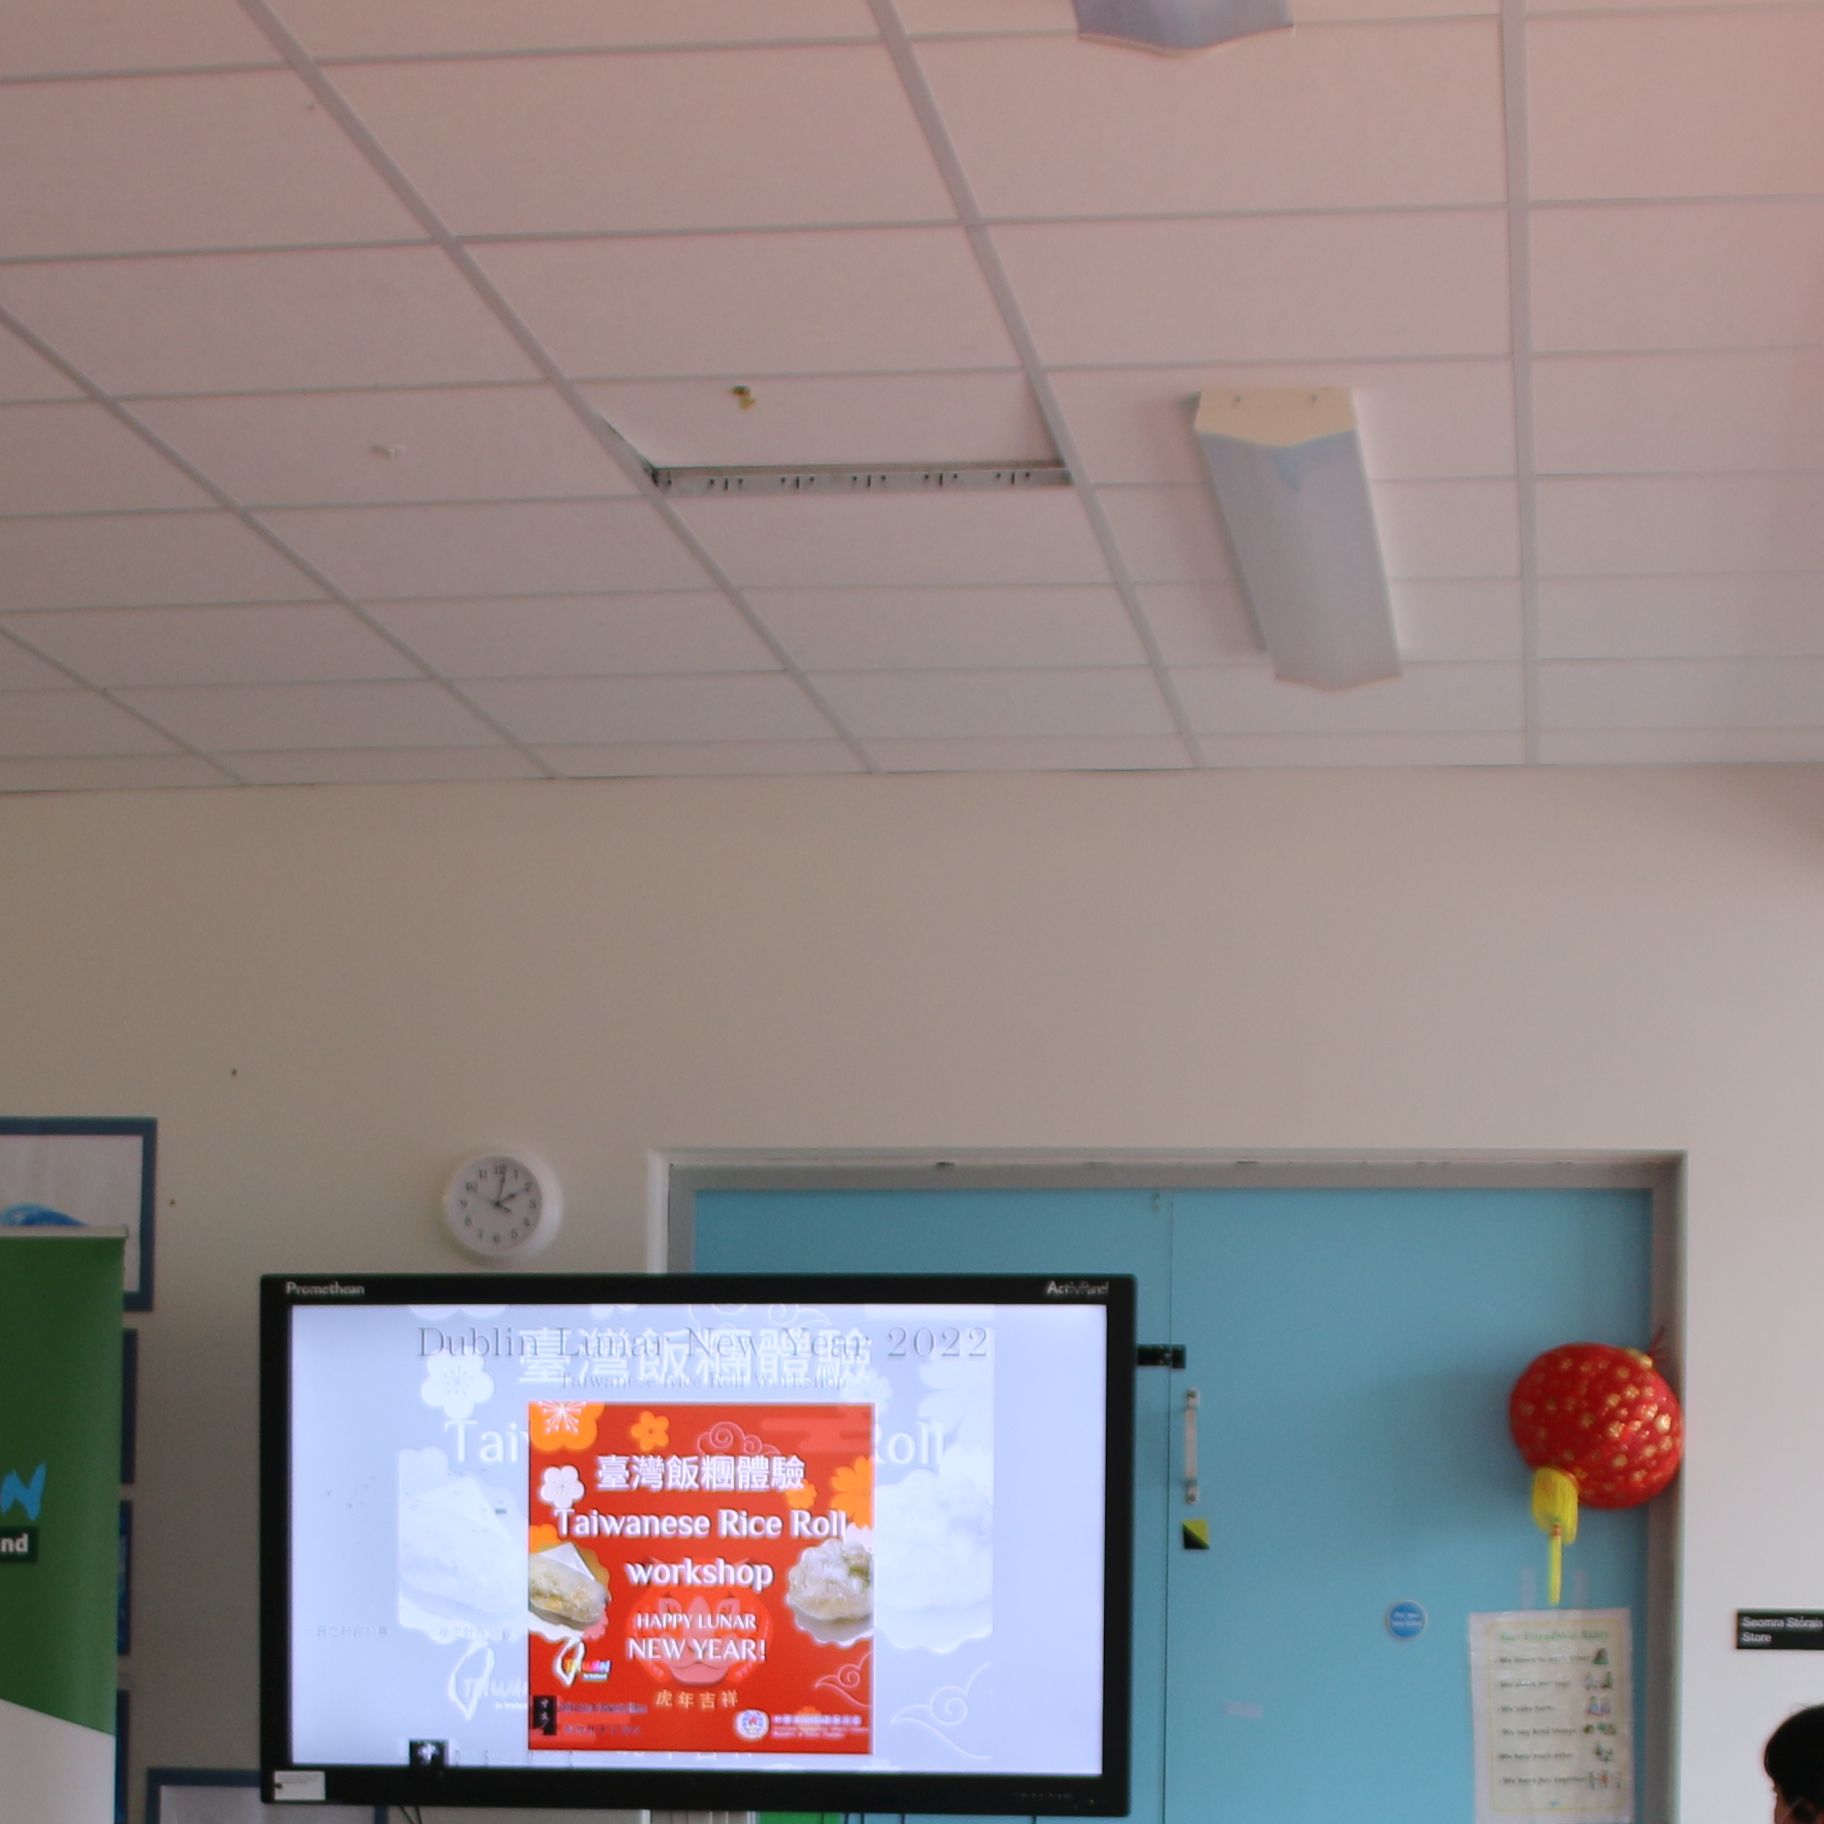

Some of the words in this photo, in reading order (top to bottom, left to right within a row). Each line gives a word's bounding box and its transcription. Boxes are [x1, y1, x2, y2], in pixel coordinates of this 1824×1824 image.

[285, 1281, 366, 1296] Promethean
[417, 1326, 539, 1358] Dublin
[556, 1327, 669, 1358] Lunar
[687, 1327, 761, 1358] New
[783, 1327, 871, 1358] Year
[887, 1326, 990, 1358] 2022
[553, 1508, 711, 1538] Taiwanese
[717, 1509, 783, 1538] Rice
[789, 1509, 848, 1538] Roll
[623, 1557, 774, 1592] workshop
[636, 1612, 692, 1631] HAPPY
[697, 1612, 757, 1631] LUNAR
[1742, 1631, 1772, 1643] Store
[627, 1637, 688, 1661] NEW
[687, 1636, 767, 1662] YEAR!
[654, 1689, 740, 1710] 虎年吉祥
